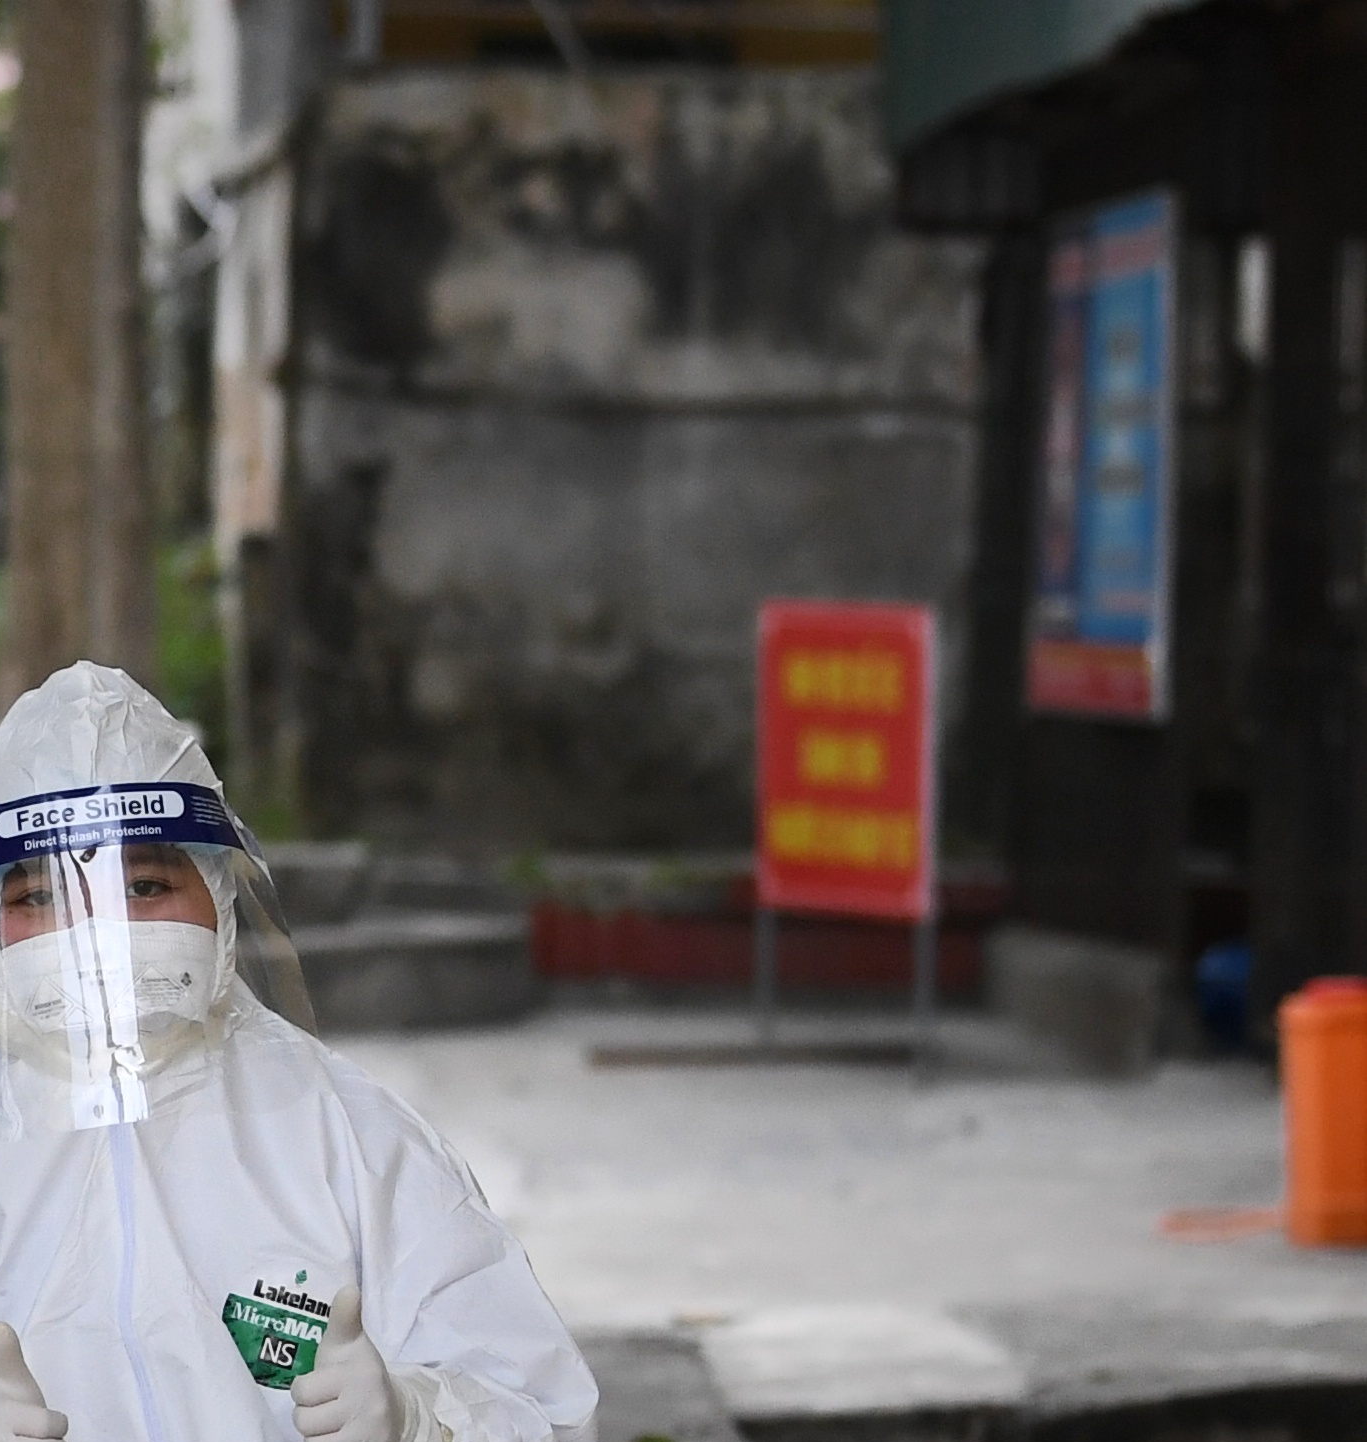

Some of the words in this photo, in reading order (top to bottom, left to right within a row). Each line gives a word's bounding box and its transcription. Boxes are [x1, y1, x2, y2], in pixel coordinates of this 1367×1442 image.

[16, 806, 76, 832] Face
[84, 794, 165, 820] Shield
[24, 835, 57, 851] Direct
[59, 831, 101, 845] Splash
[103, 825, 162, 838] Protection
[253, 1279, 331, 1319] Lakelan
[231, 1302, 323, 1344] MicroMA
[259, 1337, 296, 1368] NS
